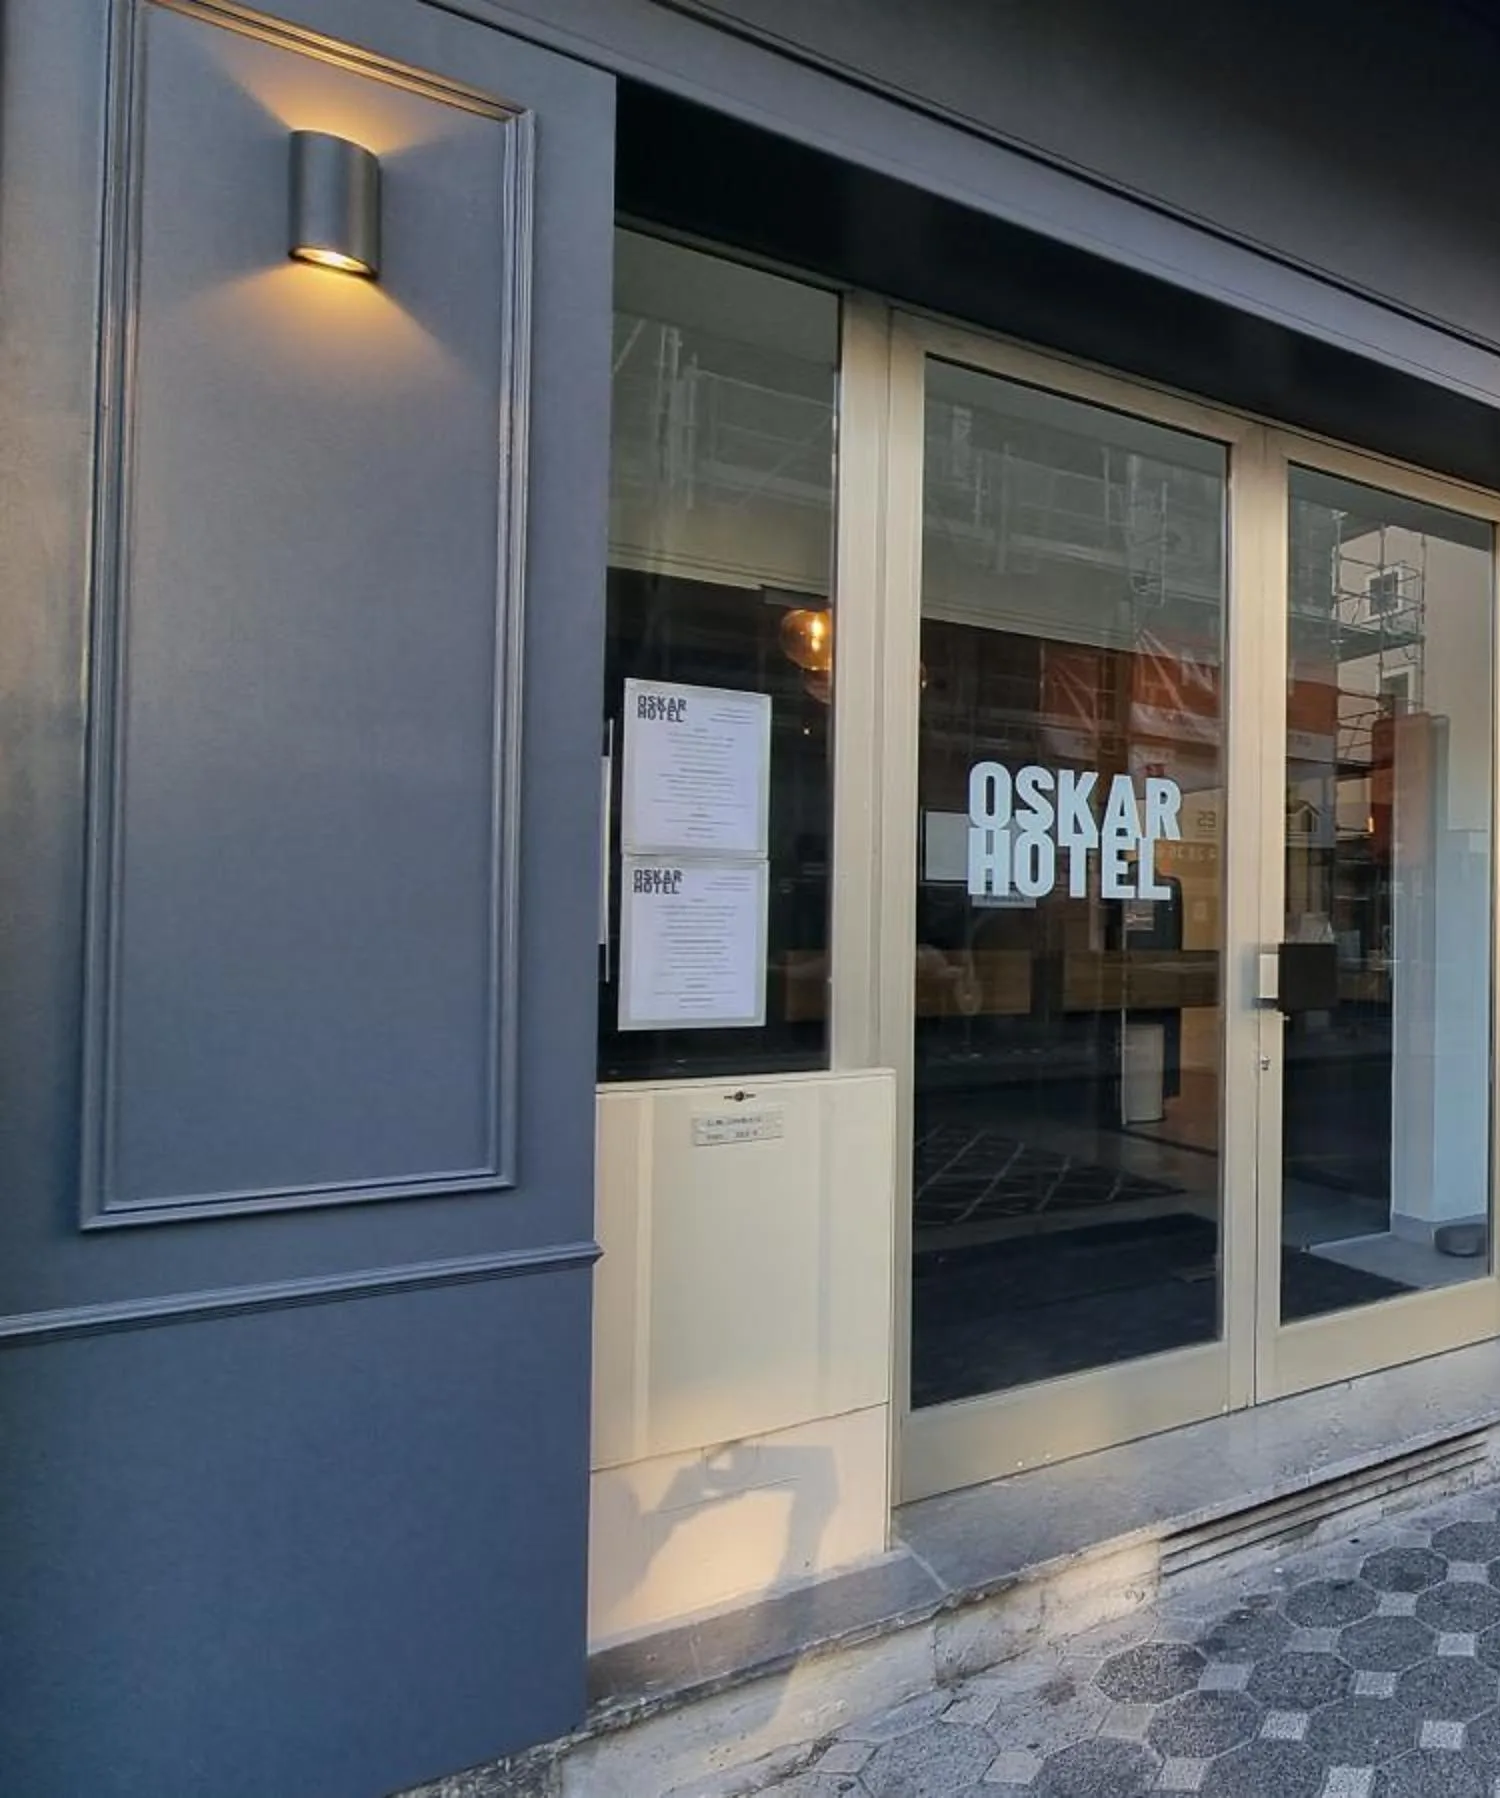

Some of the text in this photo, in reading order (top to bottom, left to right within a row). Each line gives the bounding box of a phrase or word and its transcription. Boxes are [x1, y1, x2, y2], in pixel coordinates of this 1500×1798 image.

[637, 695, 687, 711] OSKAR
[637, 705, 684, 722] HOTEL
[968, 761, 1182, 846] OSKAR
[967, 827, 1171, 899] HOTEL
[634, 869, 682, 883] OSKAR
[634, 879, 680, 894] HOTEL
